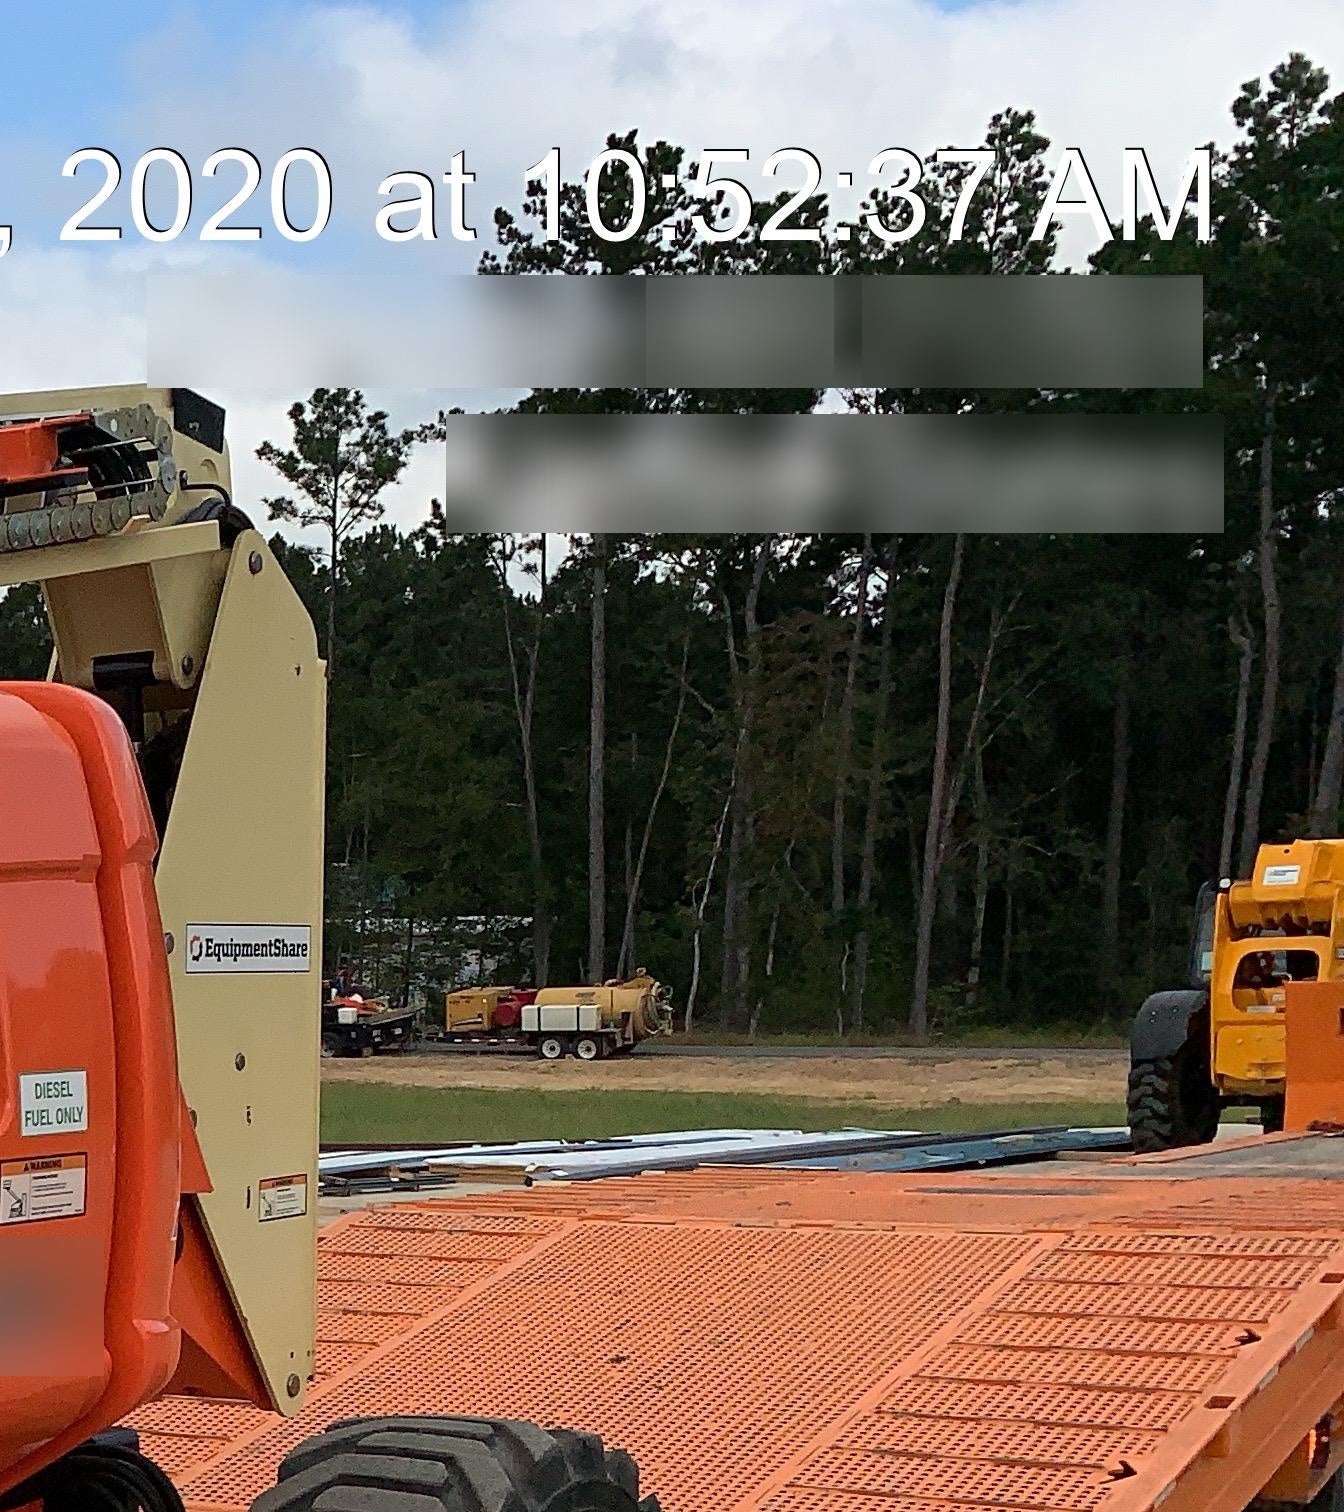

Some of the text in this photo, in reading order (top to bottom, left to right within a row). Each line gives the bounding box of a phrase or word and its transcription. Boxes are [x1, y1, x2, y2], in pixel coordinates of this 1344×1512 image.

[204, 937, 308, 962] EquipmentShare
[34, 1081, 74, 1100] DIESEL
[24, 1106, 84, 1127] FUEL ONLY
[29, 1159, 62, 1171] WARNING
